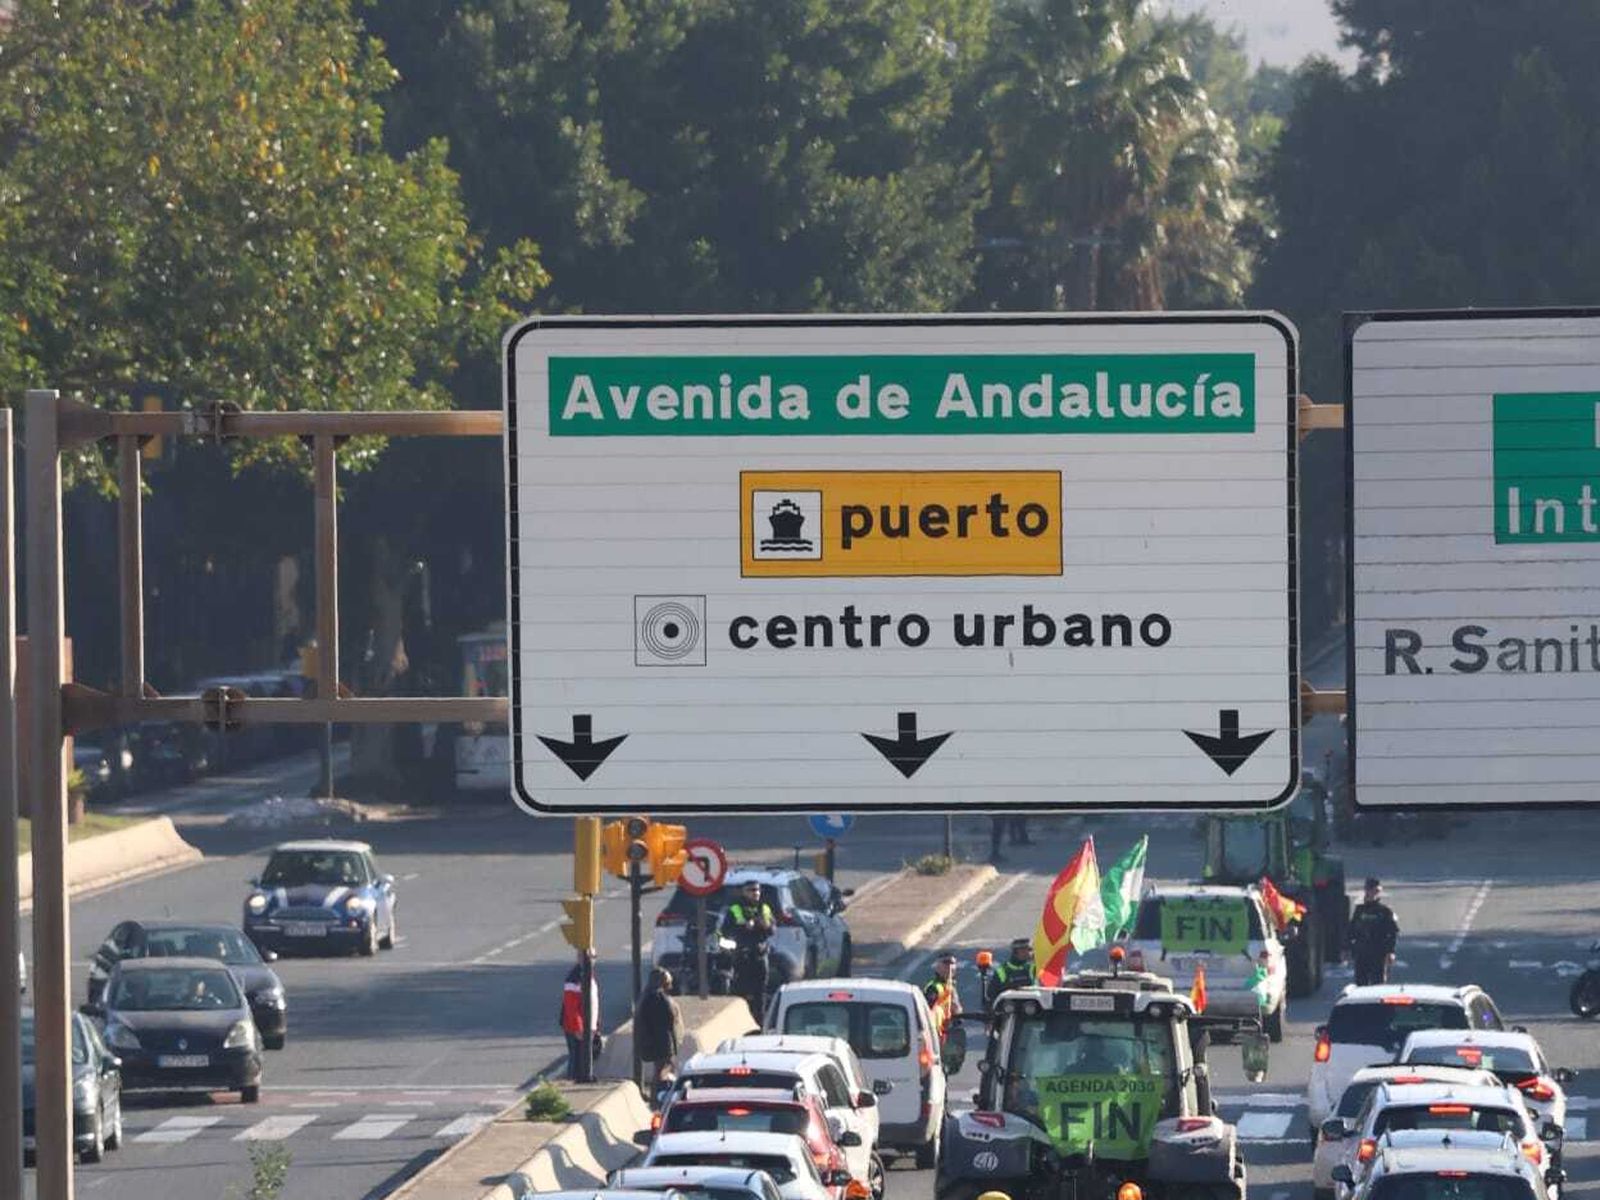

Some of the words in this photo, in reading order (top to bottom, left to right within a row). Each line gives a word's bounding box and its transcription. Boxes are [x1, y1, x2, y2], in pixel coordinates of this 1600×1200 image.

[563, 374, 810, 420] Avenida
[836, 376, 910, 419] de
[935, 372, 1243, 418] Andalucía
[841, 493, 1050, 549] puerto
[729, 605, 930, 649] centro
[953, 603, 1172, 648] urbano
[1177, 916, 1232, 942] FIN
[1046, 1080, 1115, 1093] AGENDA
[1120, 1080, 1155, 1093] 2030
[1060, 1102, 1141, 1141] FIN
